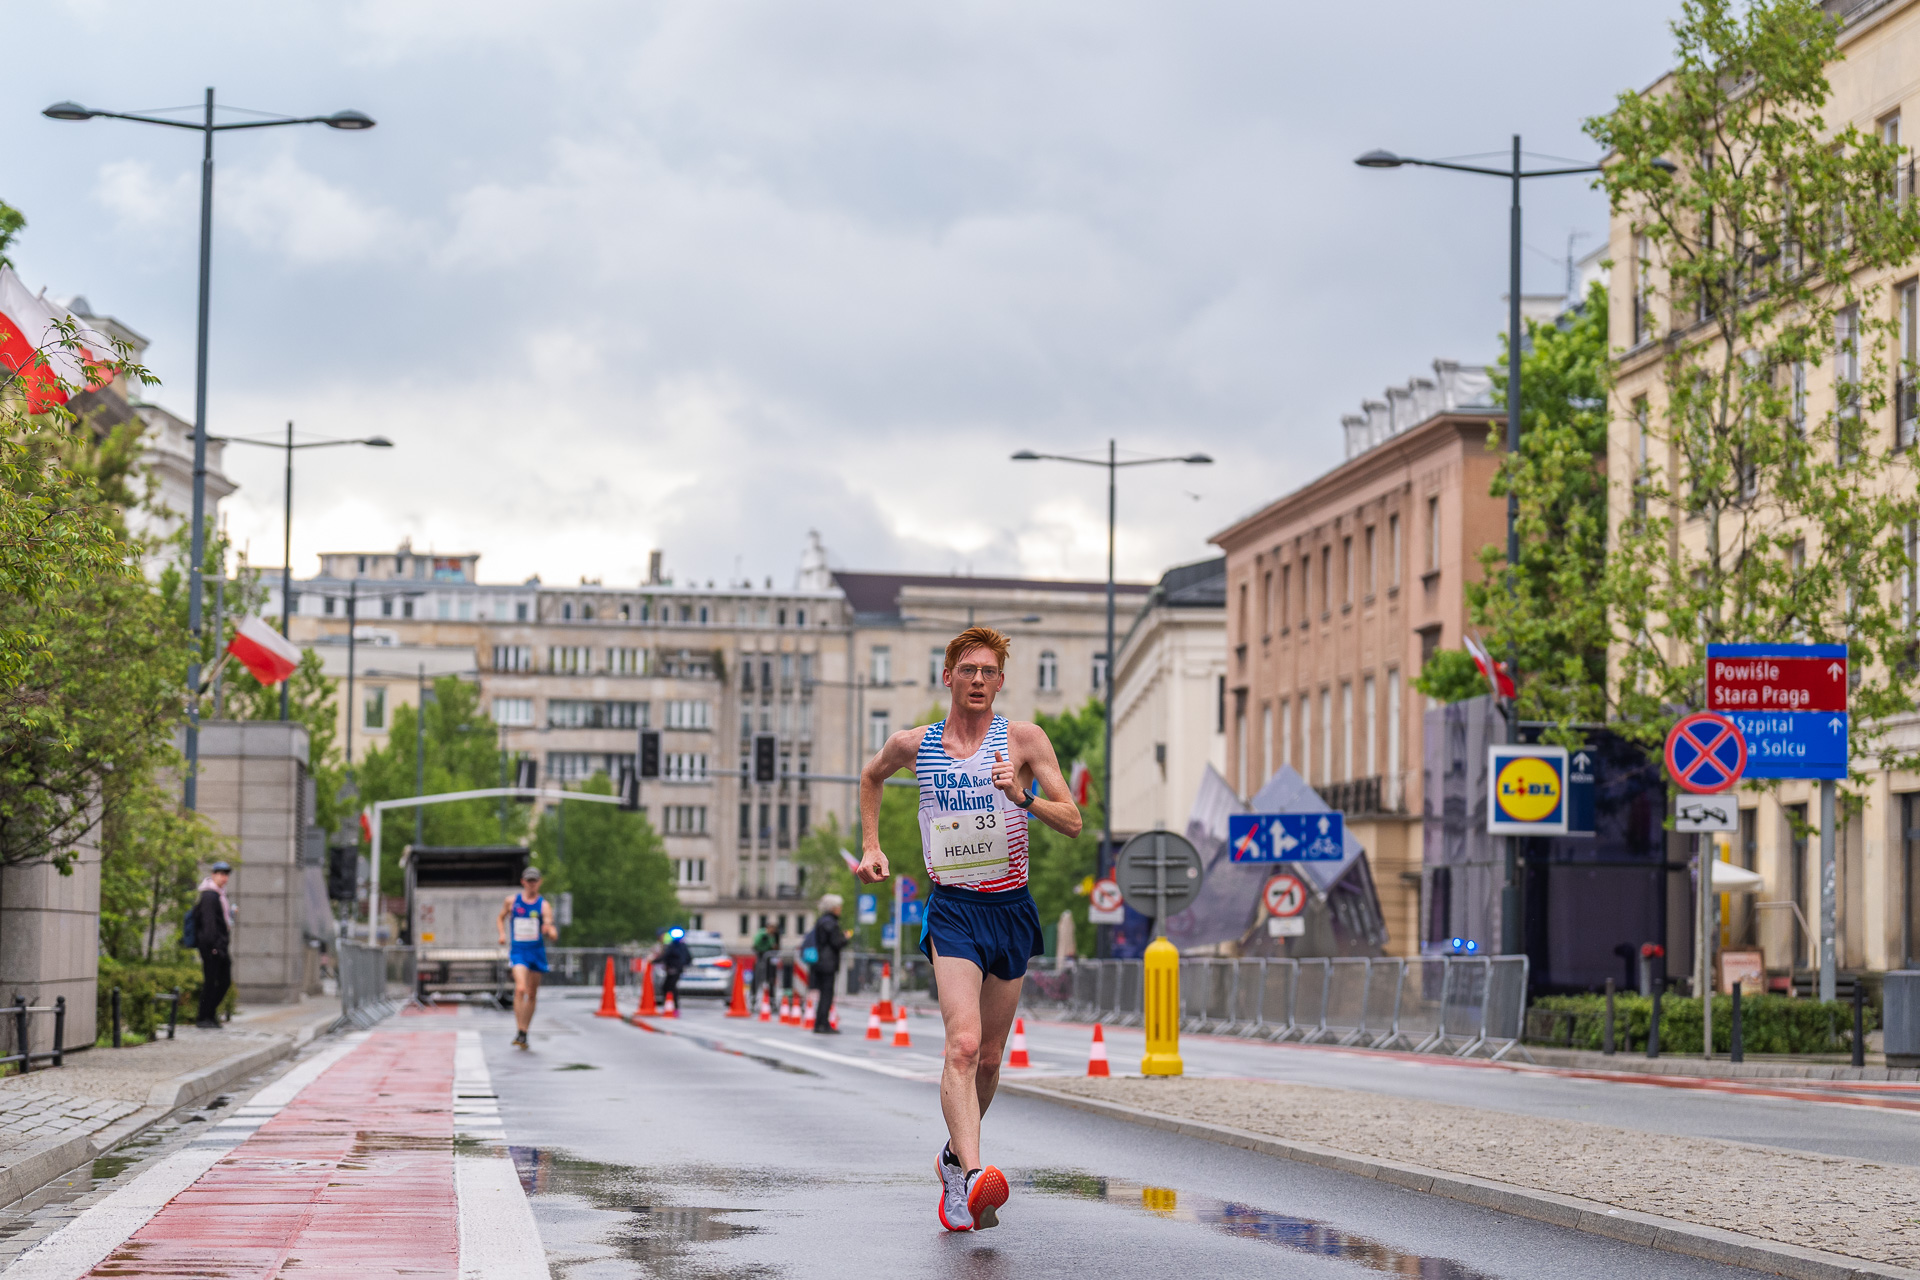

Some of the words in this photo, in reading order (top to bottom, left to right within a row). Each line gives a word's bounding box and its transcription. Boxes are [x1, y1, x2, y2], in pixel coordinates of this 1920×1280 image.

[1715, 661, 1780, 681] Powiśle
[1715, 685, 1758, 705] Stara
[1762, 685, 1810, 708] Praga
[1737, 715, 1793, 737] Szpital
[1762, 739, 1806, 756] Solcu
[934, 773, 972, 789] USA
[973, 775, 992, 788] Race
[934, 790, 995, 812] Walking
[975, 814, 996, 830] 33
[945, 842, 993, 857] HEALEY
